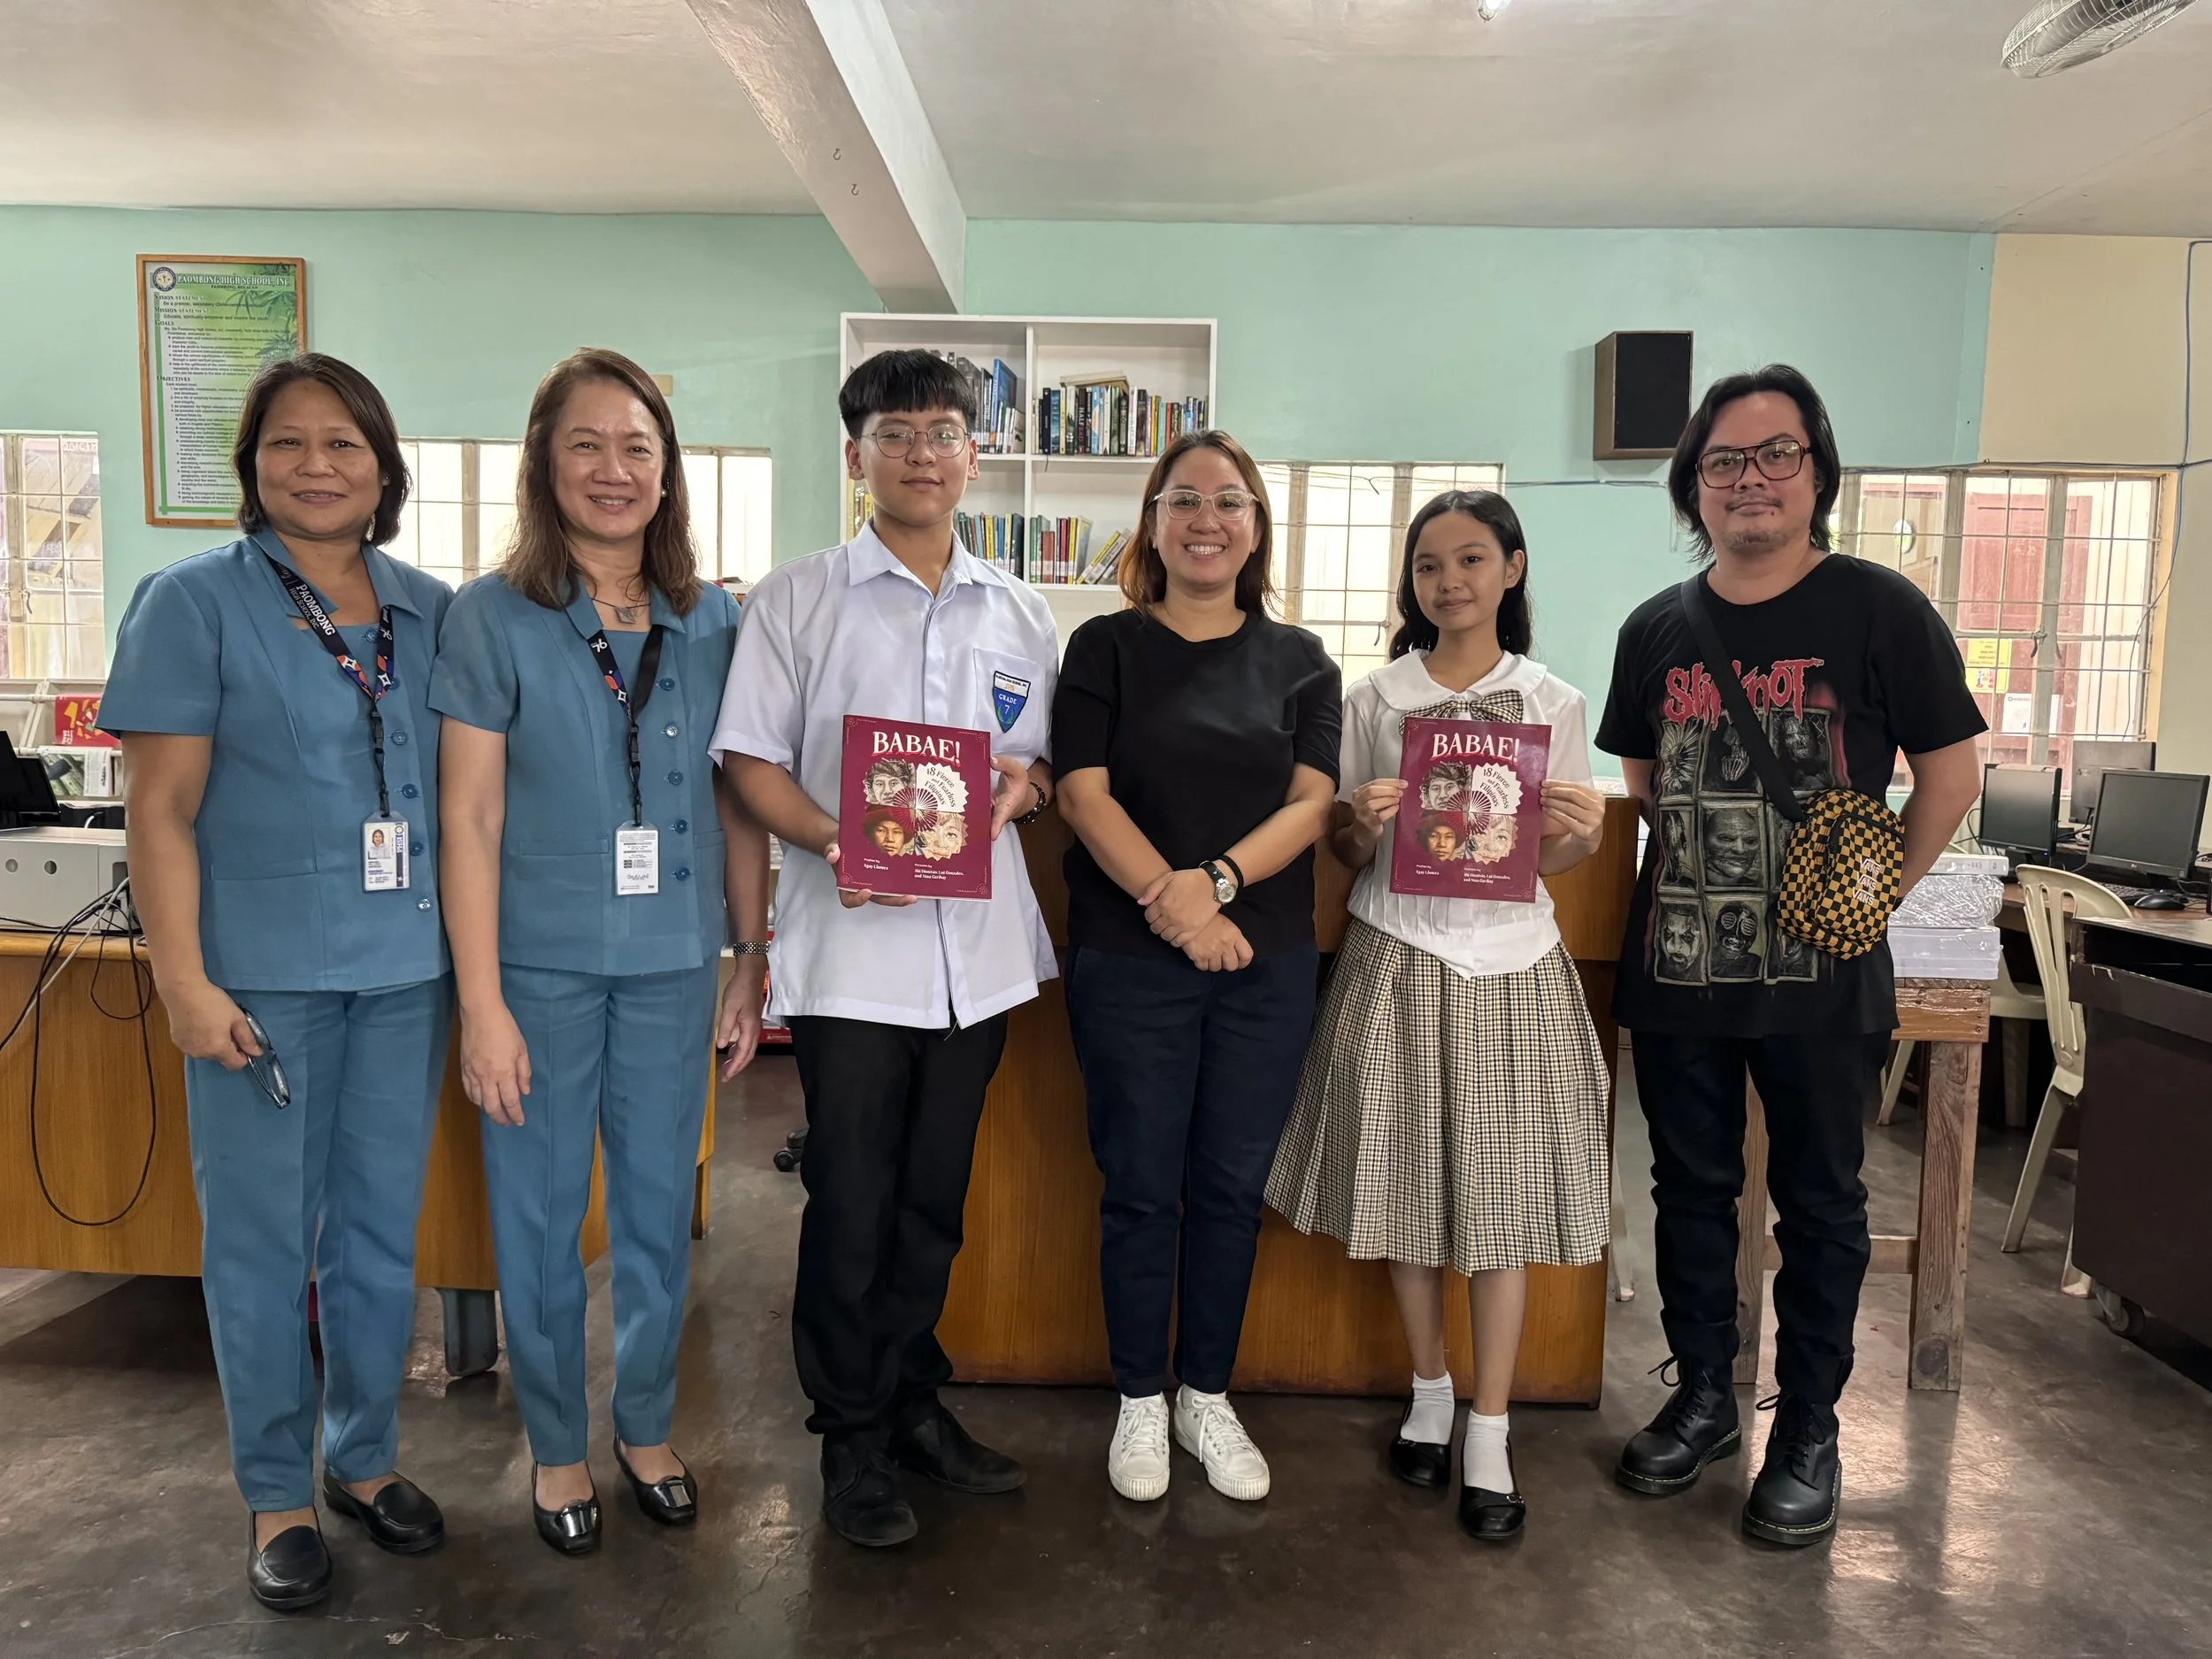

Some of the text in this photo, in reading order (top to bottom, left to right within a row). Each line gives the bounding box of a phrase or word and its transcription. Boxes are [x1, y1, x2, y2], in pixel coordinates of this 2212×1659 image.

[178, 275, 219, 284] PAOMBONG
[288, 588, 300, 602] HIGH
[296, 583, 336, 636] PAOMBONG
[998, 694, 1018, 705] GRADE
[1004, 704, 1010, 715] 7
[872, 731, 962, 764] BABAE!
[1431, 732, 1520, 764] BABAE!
[926, 766, 955, 788] 18 Fierce
[1483, 767, 1510, 788] 18 Fierce
[925, 780, 947, 805] Filipinas
[938, 781, 956, 808] Fearless
[1479, 782, 1500, 807] Filipinas
[1494, 782, 1509, 809] Fearless
[1860, 855, 1881, 876] VANS
[1856, 871, 1878, 891] VANS
[1853, 886, 1875, 906] VANS
